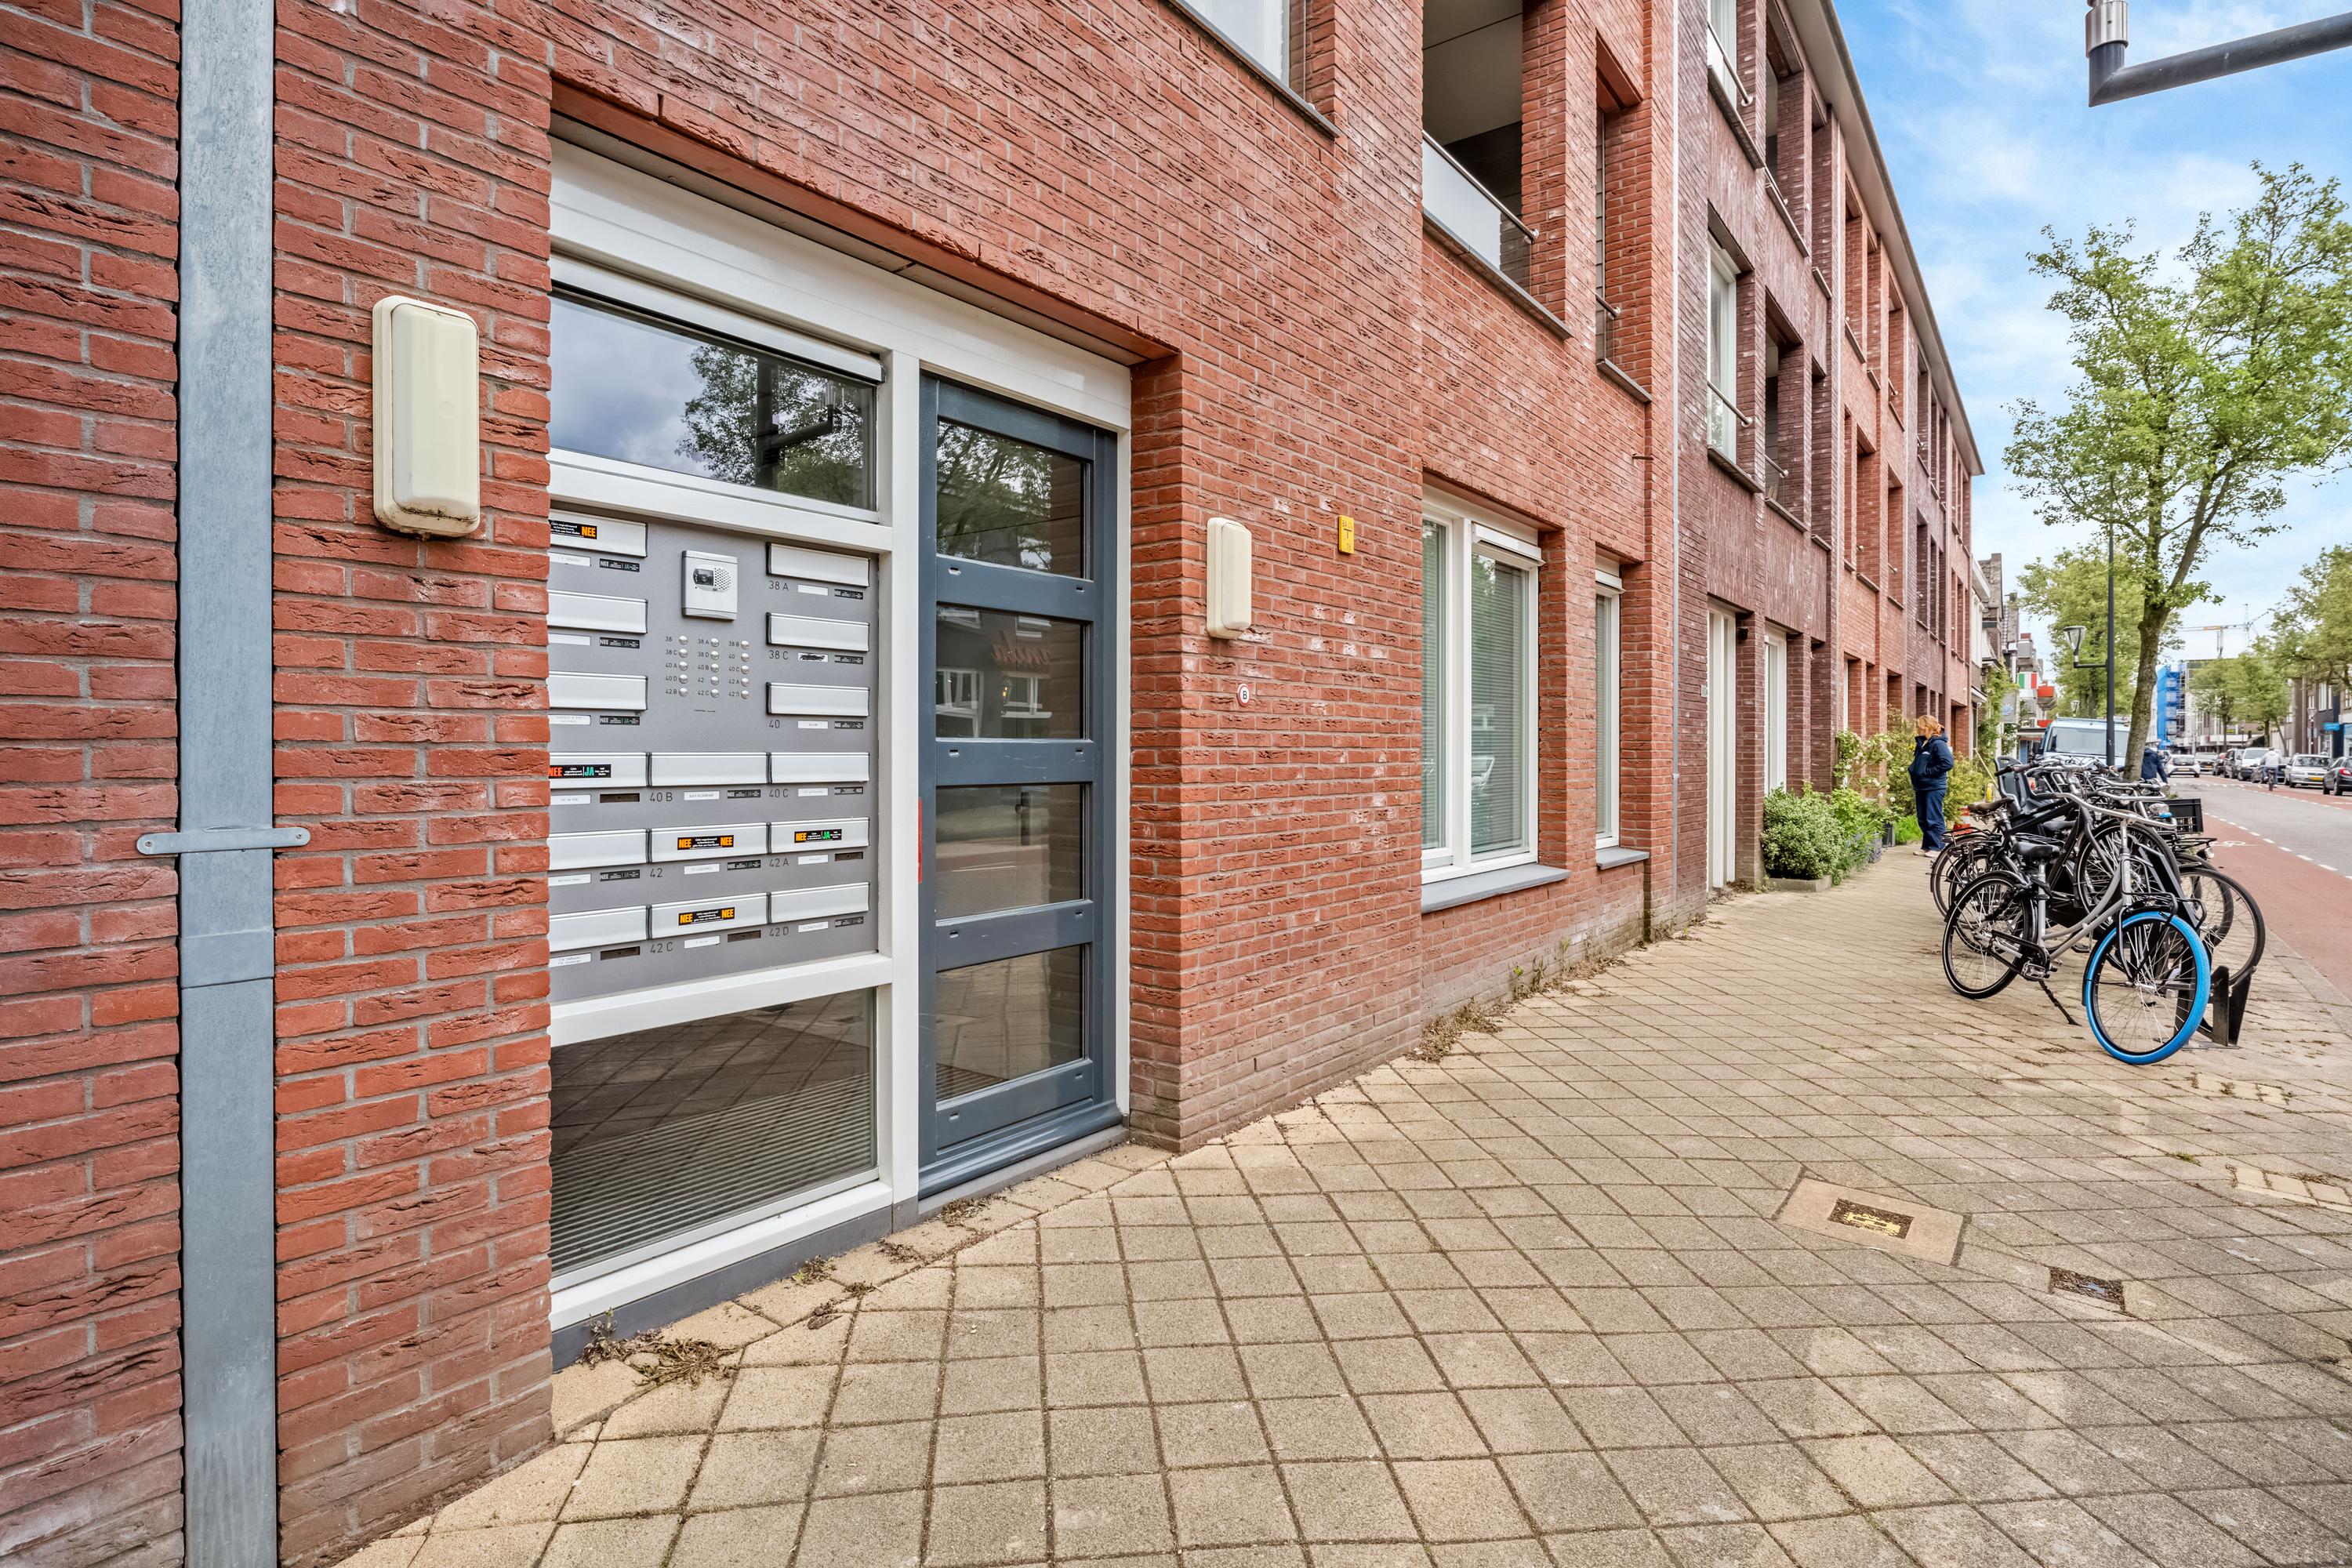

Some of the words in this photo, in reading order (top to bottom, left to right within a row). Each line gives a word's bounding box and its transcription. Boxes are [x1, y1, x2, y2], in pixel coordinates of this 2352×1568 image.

[581, 526, 596, 538] NEE
[769, 581, 780, 590] 38
[782, 583, 789, 591] A
[769, 651, 780, 659] 38
[782, 651, 789, 660] C
[1243, 690, 1247, 700] B
[769, 720, 780, 729] 40
[548, 767, 563, 777] NEE
[584, 766, 595, 776] JA
[650, 793, 663, 802] 40
[666, 792, 673, 802] B
[769, 789, 781, 798] 40
[782, 788, 789, 797] C
[796, 832, 807, 841] NEE
[822, 831, 830, 840] JA
[679, 838, 692, 848] NEE
[720, 837, 733, 846] NEE
[769, 858, 781, 868] 42
[782, 857, 789, 867] A
[650, 868, 663, 878] 42
[680, 913, 693, 924] NEE
[721, 908, 734, 919] NEE
[769, 928, 781, 937] 42
[782, 926, 789, 936] D
[651, 943, 663, 954] 42
[666, 942, 673, 952] C
